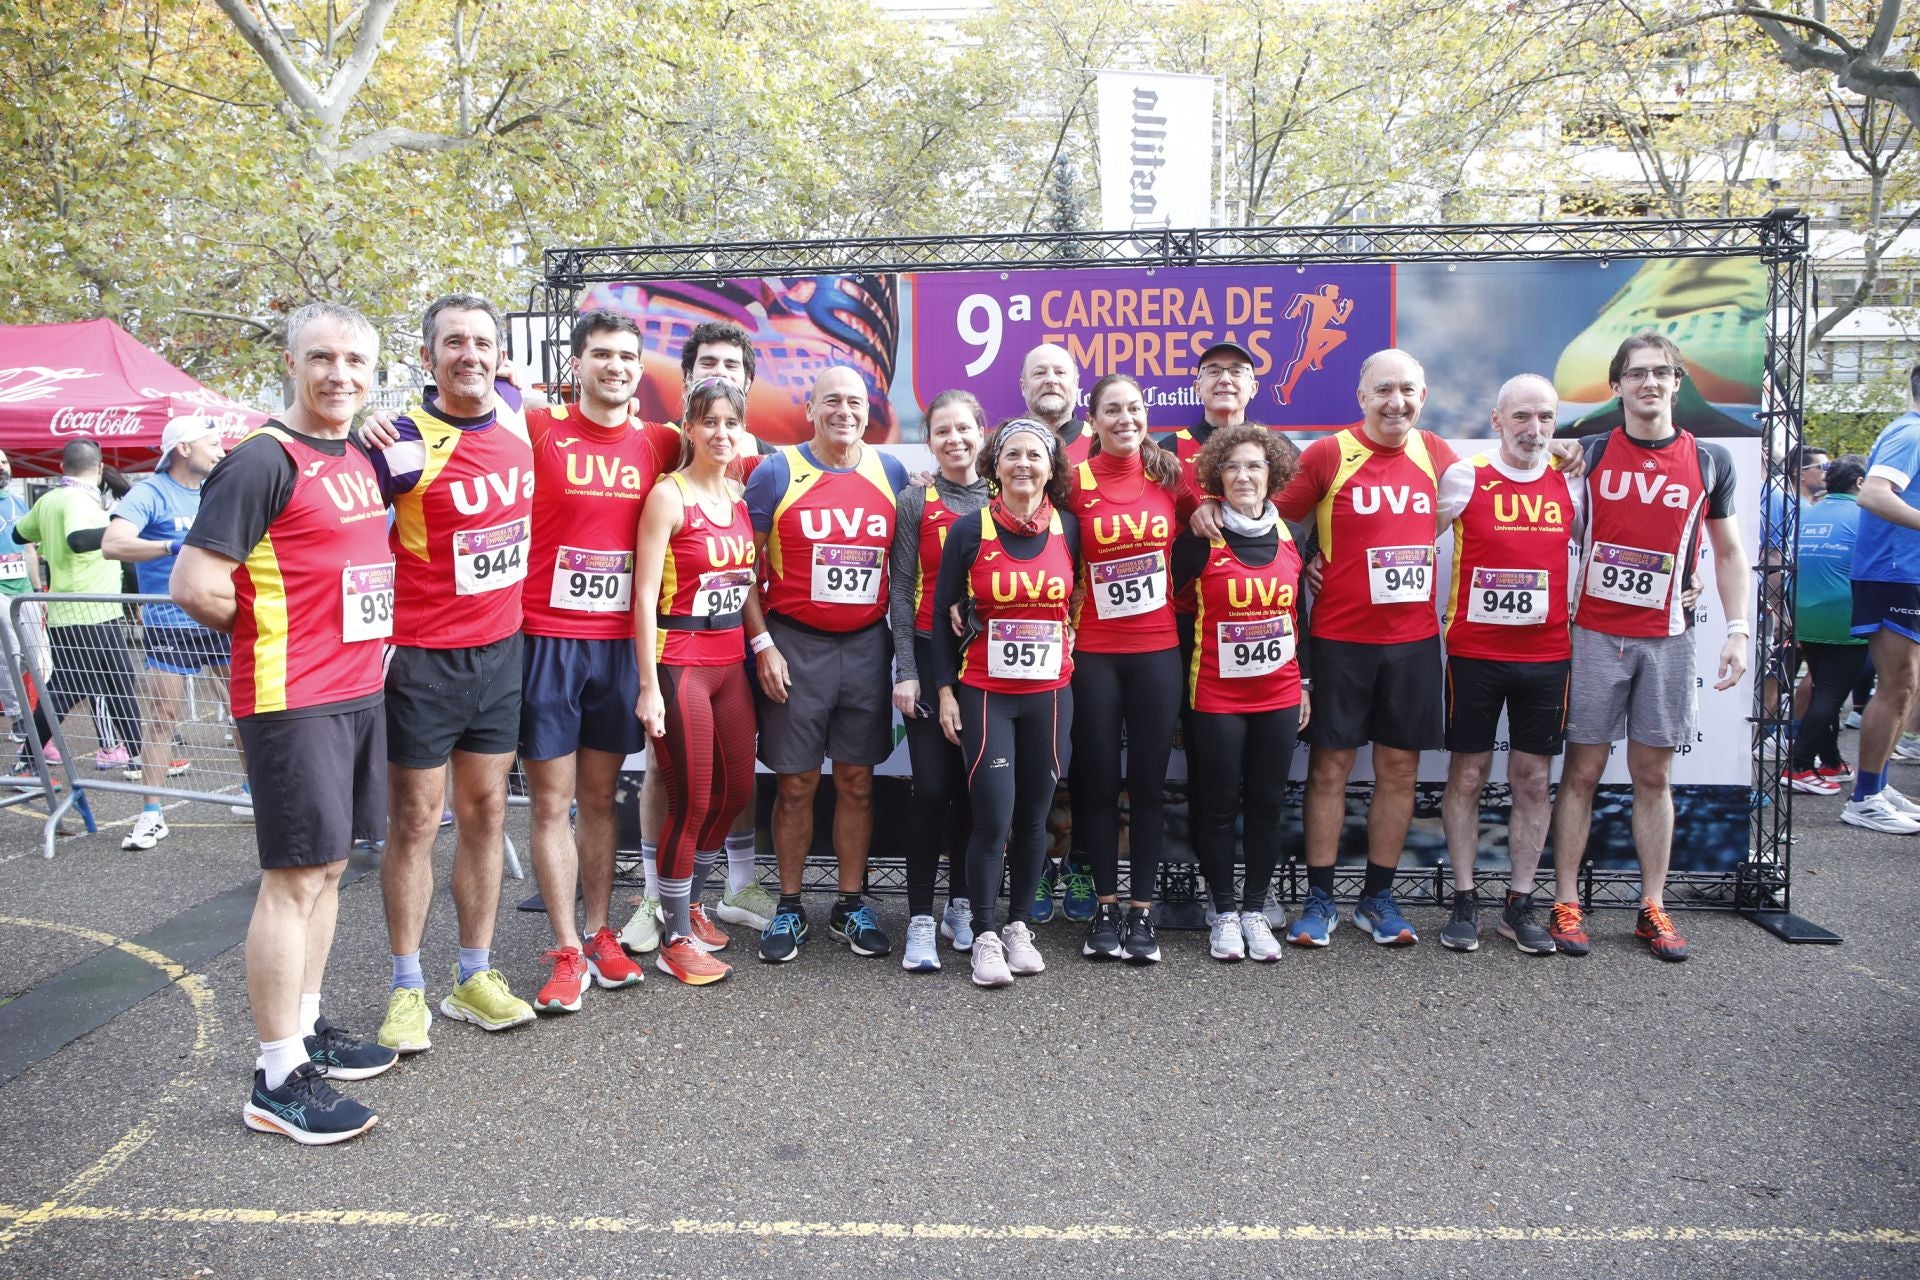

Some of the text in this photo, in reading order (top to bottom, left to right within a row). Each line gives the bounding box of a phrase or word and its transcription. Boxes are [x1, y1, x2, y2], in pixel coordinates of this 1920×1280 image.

[957, 286, 1273, 377] 9ª CARRERA DE
[1042, 330, 1272, 377] MPRESS
[1143, 386, 1204, 407] Castill
[50, 405, 149, 436] Coca-Cola
[566, 453, 641, 490] UVa
[320, 470, 382, 511] UVa
[449, 467, 535, 515] UVa
[1352, 485, 1431, 515] UVa
[1600, 469, 1690, 509] UVa
[800, 507, 887, 540] UVa
[1494, 494, 1562, 524] UVa
[1094, 511, 1168, 545] UVa
[474, 545, 521, 579] 944
[706, 535, 755, 567] UVa
[570, 573, 619, 599] 950
[828, 567, 872, 591] 937
[991, 570, 1066, 602] UVa
[1108, 576, 1154, 605] 951
[1227, 577, 1294, 608] UVa
[1385, 567, 1425, 590] 949
[1602, 566, 1653, 594] 938
[708, 588, 741, 616] 945
[1483, 590, 1532, 613] 948
[1003, 643, 1050, 666] 957
[1234, 640, 1281, 665] 946
